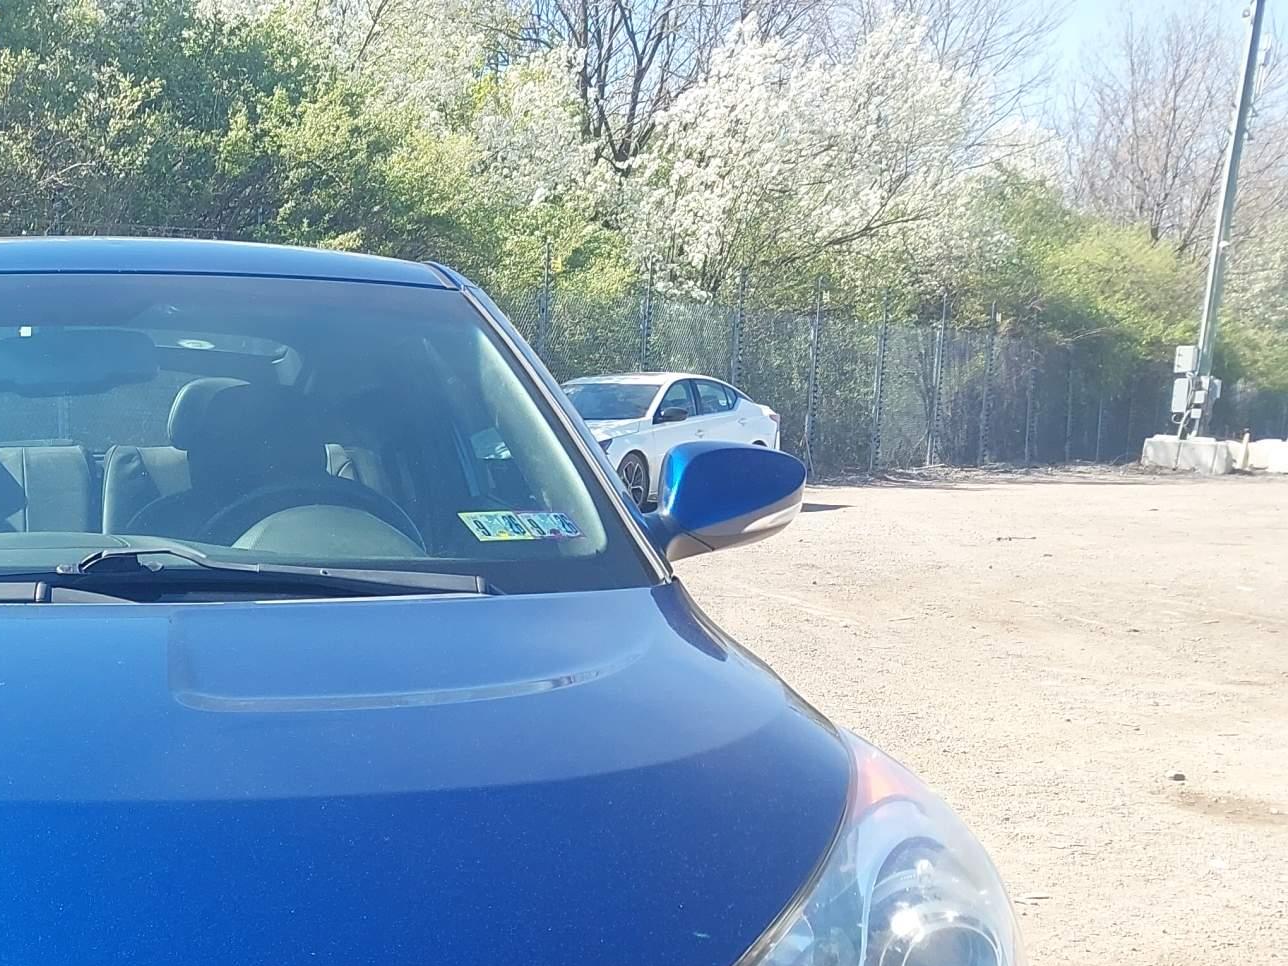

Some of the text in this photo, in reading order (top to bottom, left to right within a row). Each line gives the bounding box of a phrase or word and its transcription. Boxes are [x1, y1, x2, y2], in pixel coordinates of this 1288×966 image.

[473, 514, 527, 537] 9 26
[527, 514, 579, 536] 9 26
